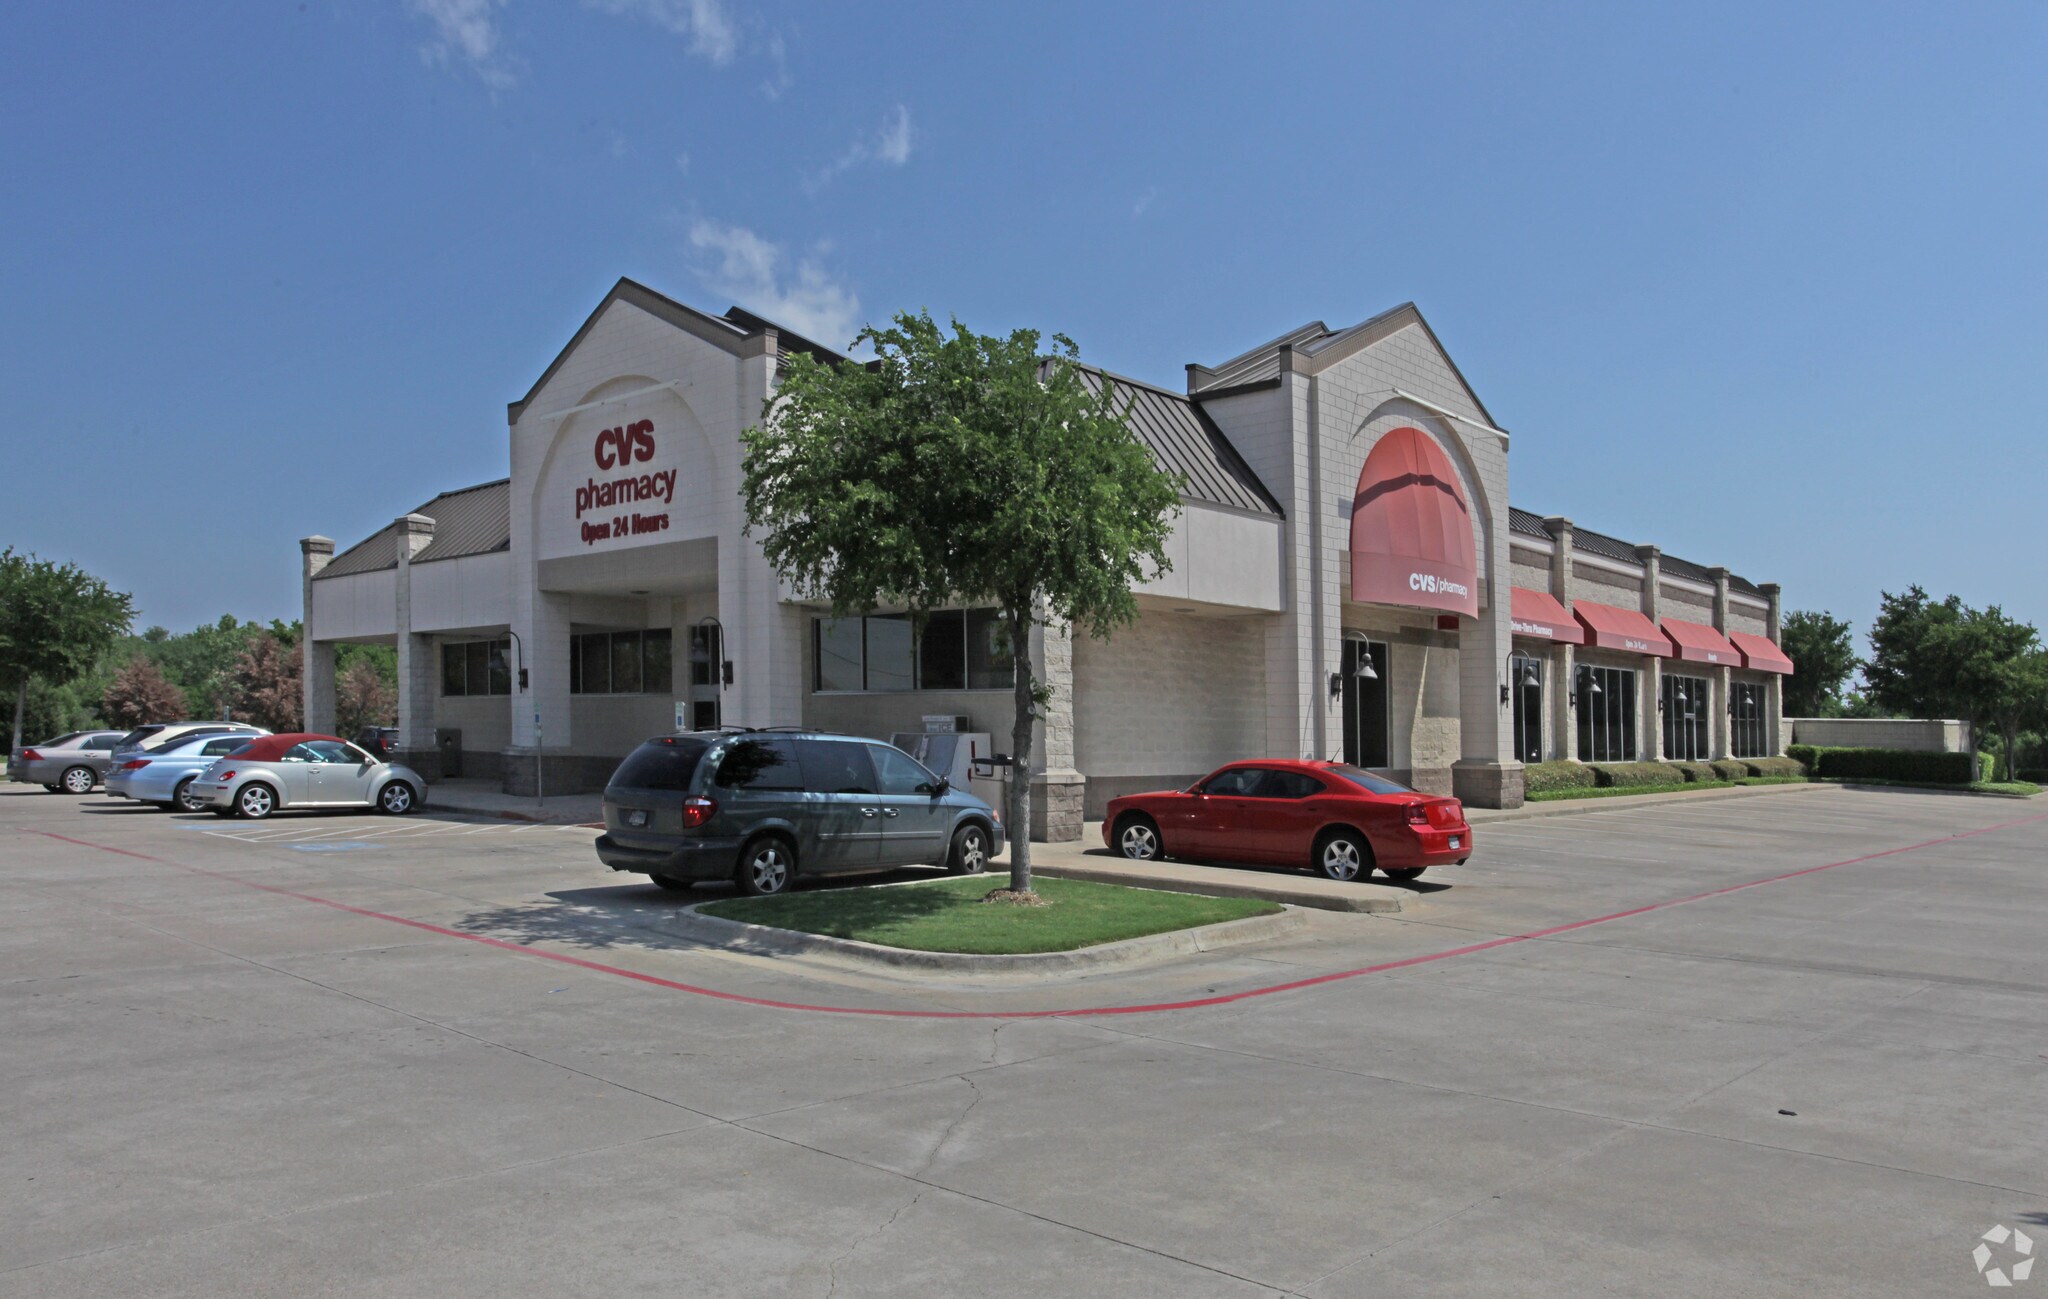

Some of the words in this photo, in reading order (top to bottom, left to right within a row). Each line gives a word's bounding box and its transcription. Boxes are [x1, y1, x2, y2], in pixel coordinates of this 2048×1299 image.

[595, 419, 655, 470] CVS
[576, 468, 677, 519] pharmacy
[581, 521, 610, 546] Open
[613, 516, 629, 537] 24
[631, 513, 669, 535] Hours
